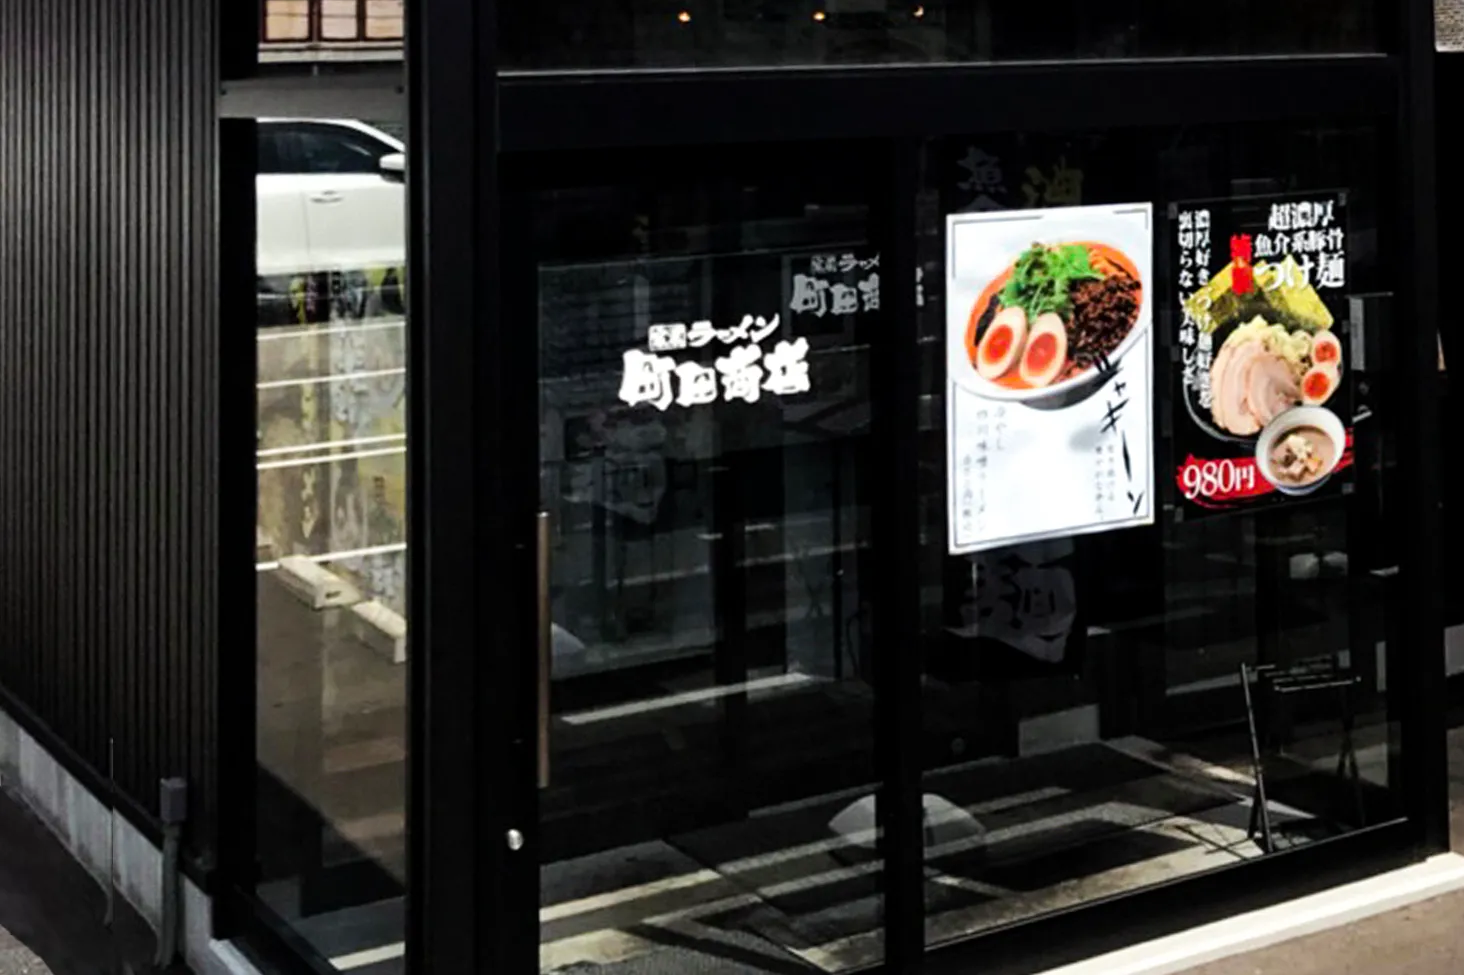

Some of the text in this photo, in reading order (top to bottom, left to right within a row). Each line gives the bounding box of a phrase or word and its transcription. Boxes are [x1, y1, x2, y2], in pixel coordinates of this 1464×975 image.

[1268, 200, 1334, 231] 超濃厚
[1254, 227, 1344, 258] 魚介系豚骨
[1253, 251, 1345, 290] つけ麺
[618, 337, 811, 411] 町田商店
[1182, 458, 1255, 500] 980円
